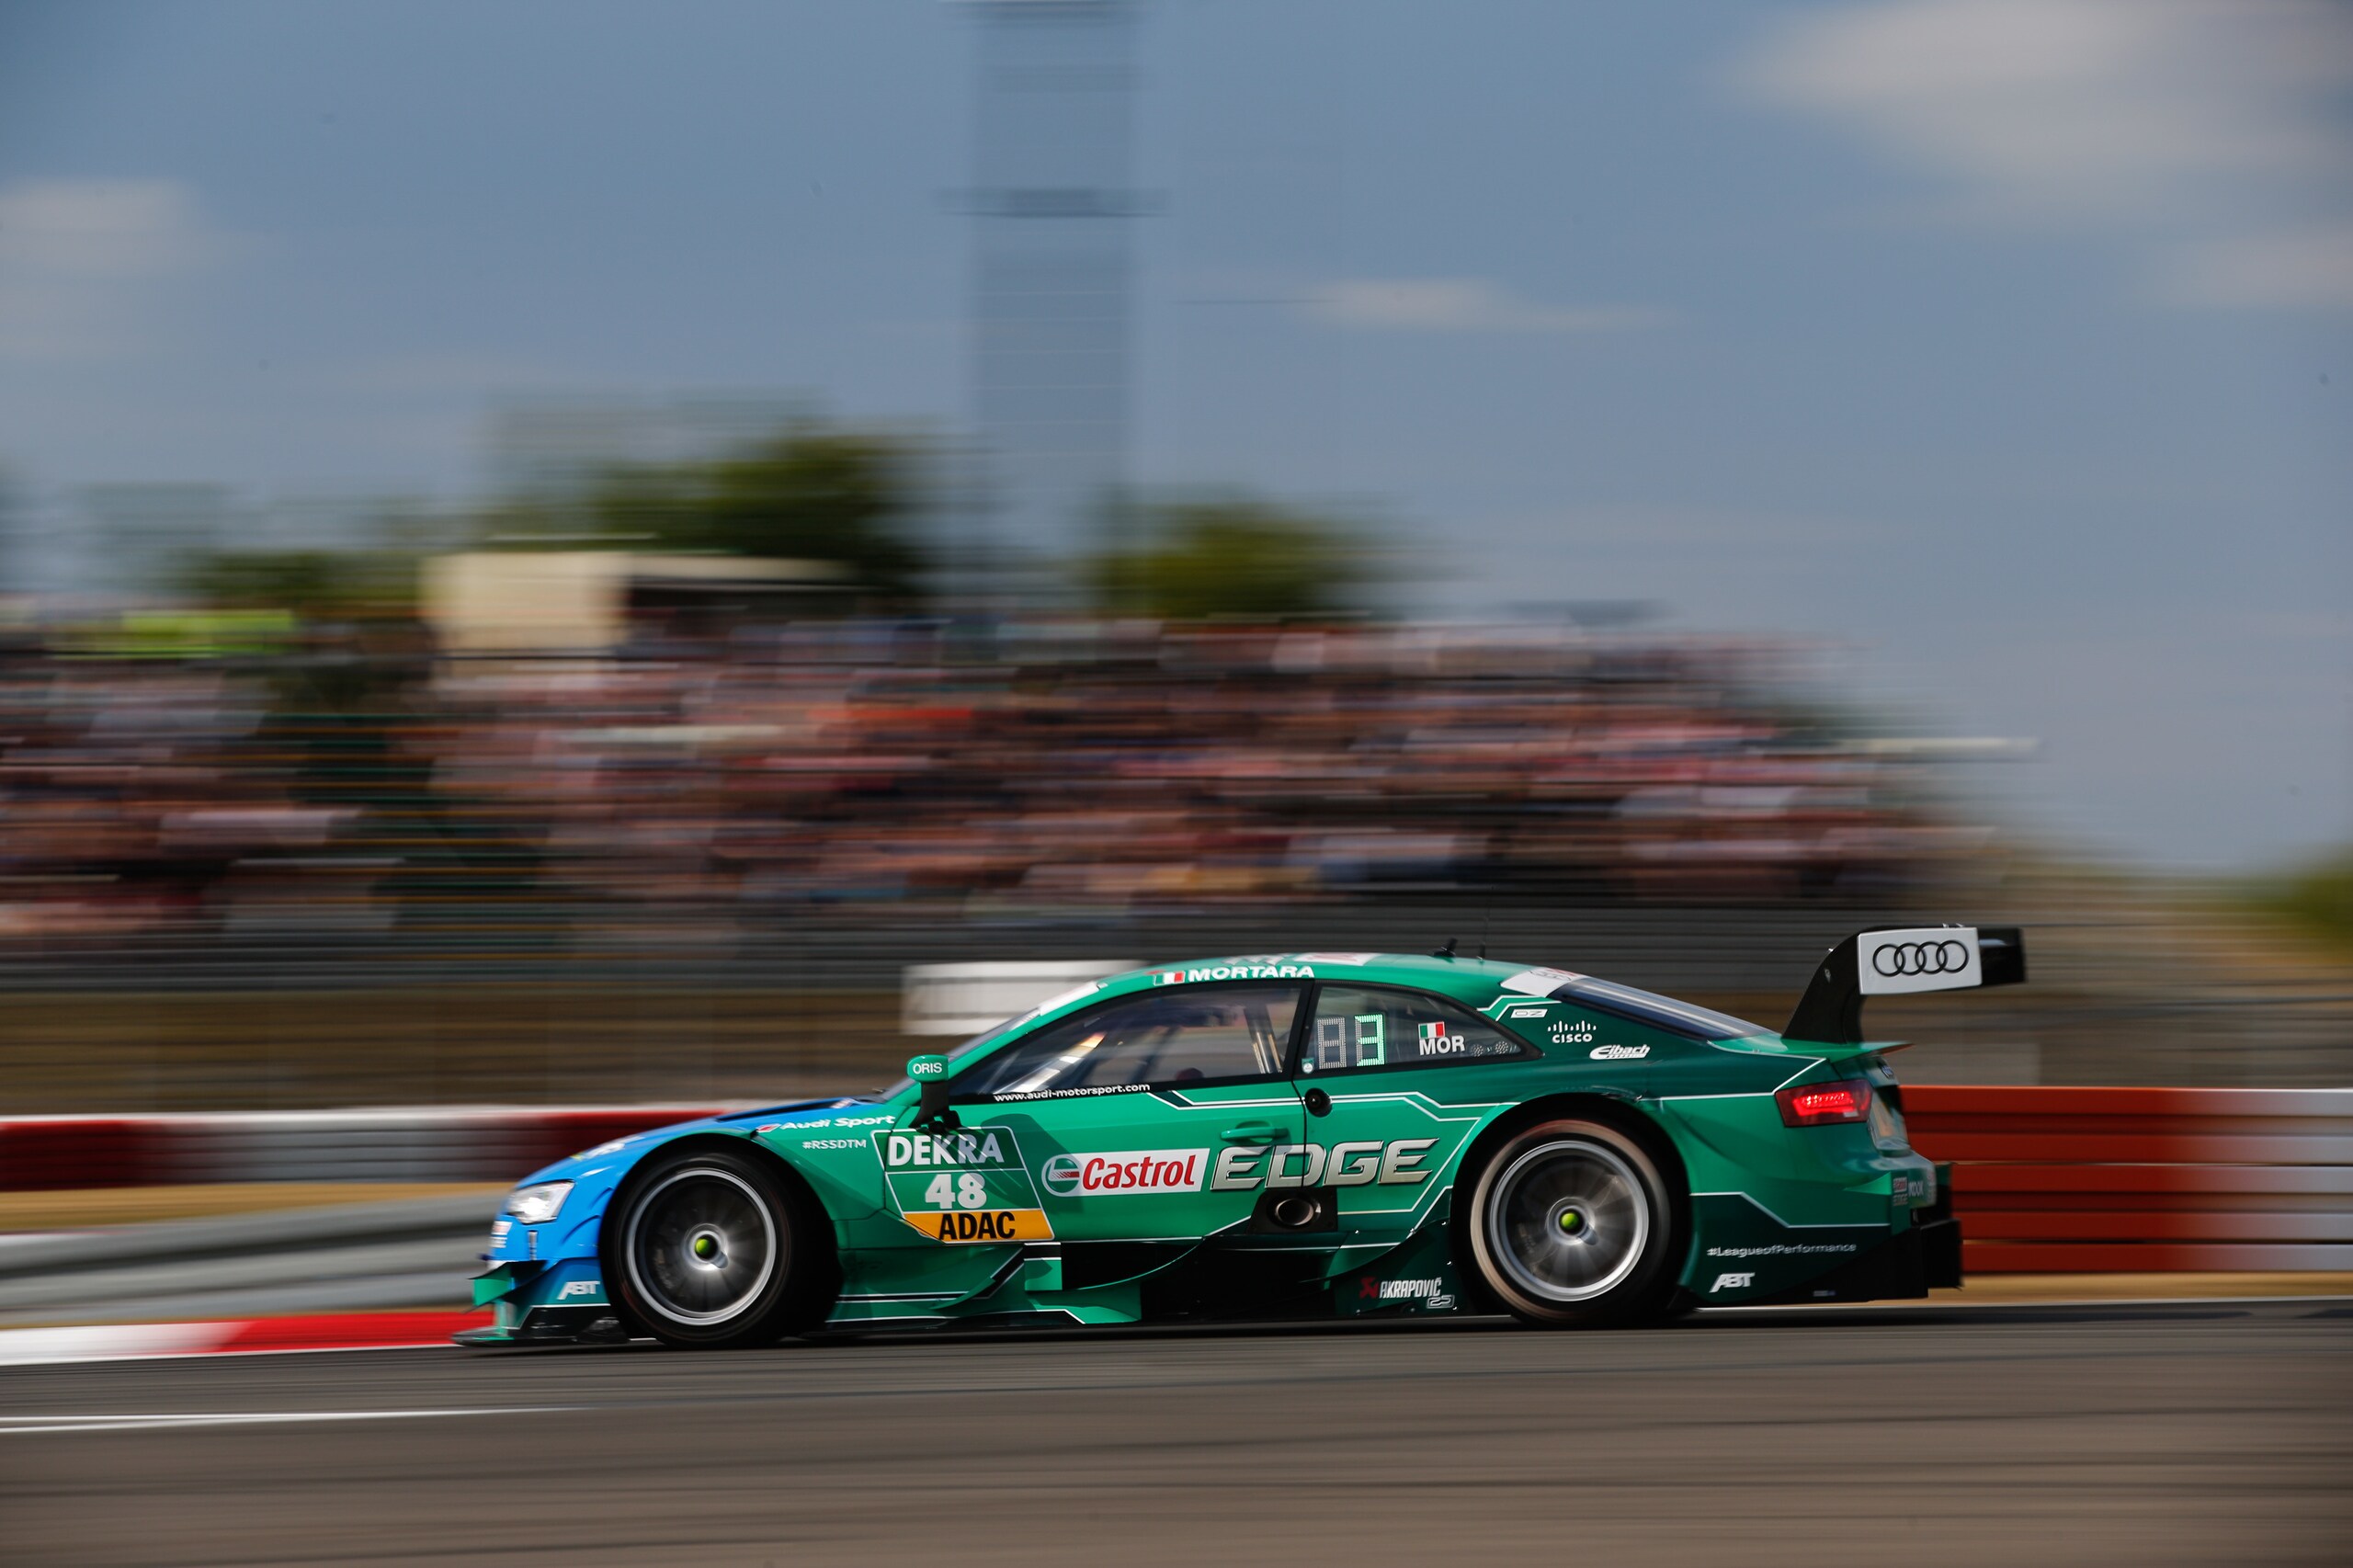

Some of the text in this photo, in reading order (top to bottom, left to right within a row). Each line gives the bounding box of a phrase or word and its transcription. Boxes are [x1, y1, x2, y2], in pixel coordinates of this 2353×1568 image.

[1188, 965, 1315, 983] MORTARA
[1419, 1035, 1466, 1055] MOR
[913, 1062, 943, 1074] ORIS
[994, 1084, 1151, 1101] www.audi-motorsport.com
[779, 1115, 896, 1130] Audi Sport
[888, 1132, 1005, 1166] DEKRA
[1082, 1154, 1196, 1190] Castrol
[1211, 1138, 1439, 1190] EDGE
[925, 1173, 987, 1210] 48
[938, 1211, 1016, 1241] ADAC
[1707, 1244, 1857, 1257] #LeagueofPerformance
[556, 1280, 600, 1301] ABT
[1710, 1272, 1756, 1293] ABT
